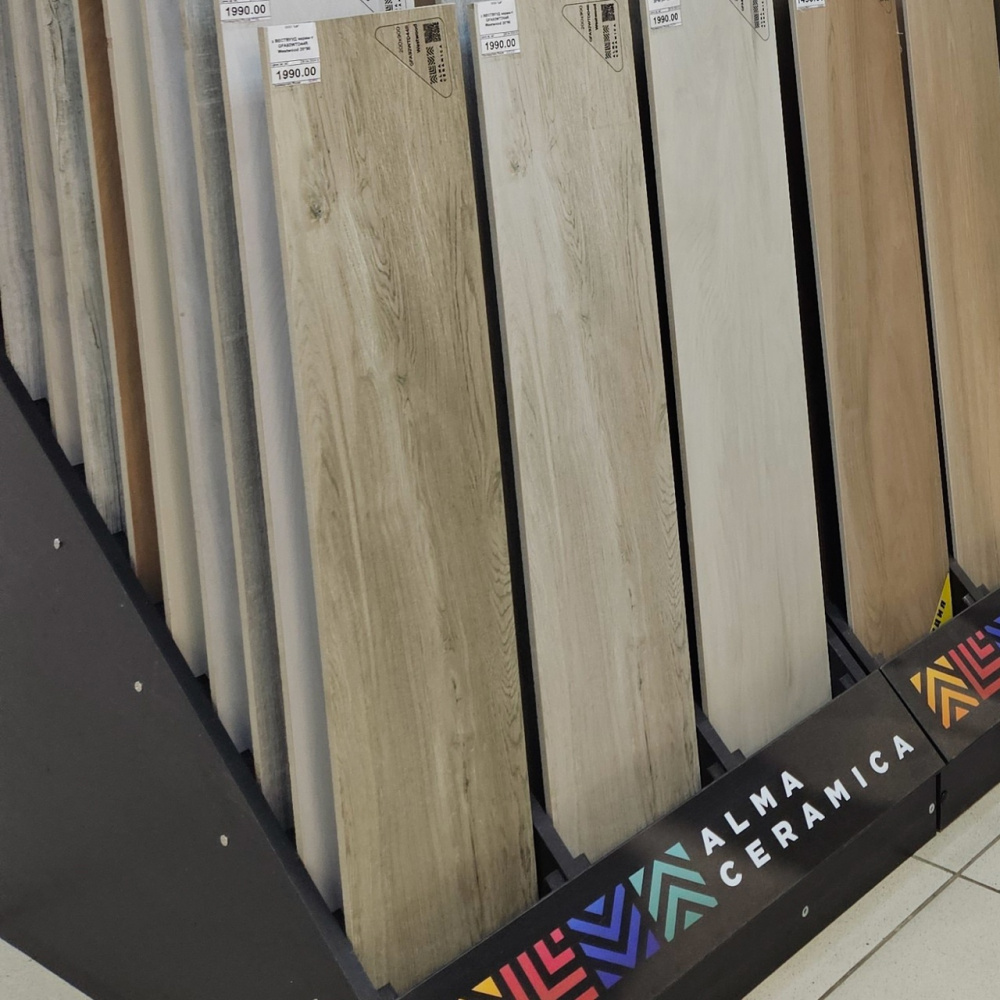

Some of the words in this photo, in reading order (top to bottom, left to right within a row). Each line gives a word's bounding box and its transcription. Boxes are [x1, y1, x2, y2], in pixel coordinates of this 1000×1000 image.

[225, 4, 265, 16] 1990.00
[653, 13, 678, 24] 1990.00
[485, 38, 516, 50] 1990.00
[277, 67, 316, 80] 1990.00
[701, 770, 804, 856] ALMA
[720, 735, 914, 886] CERAMICA
